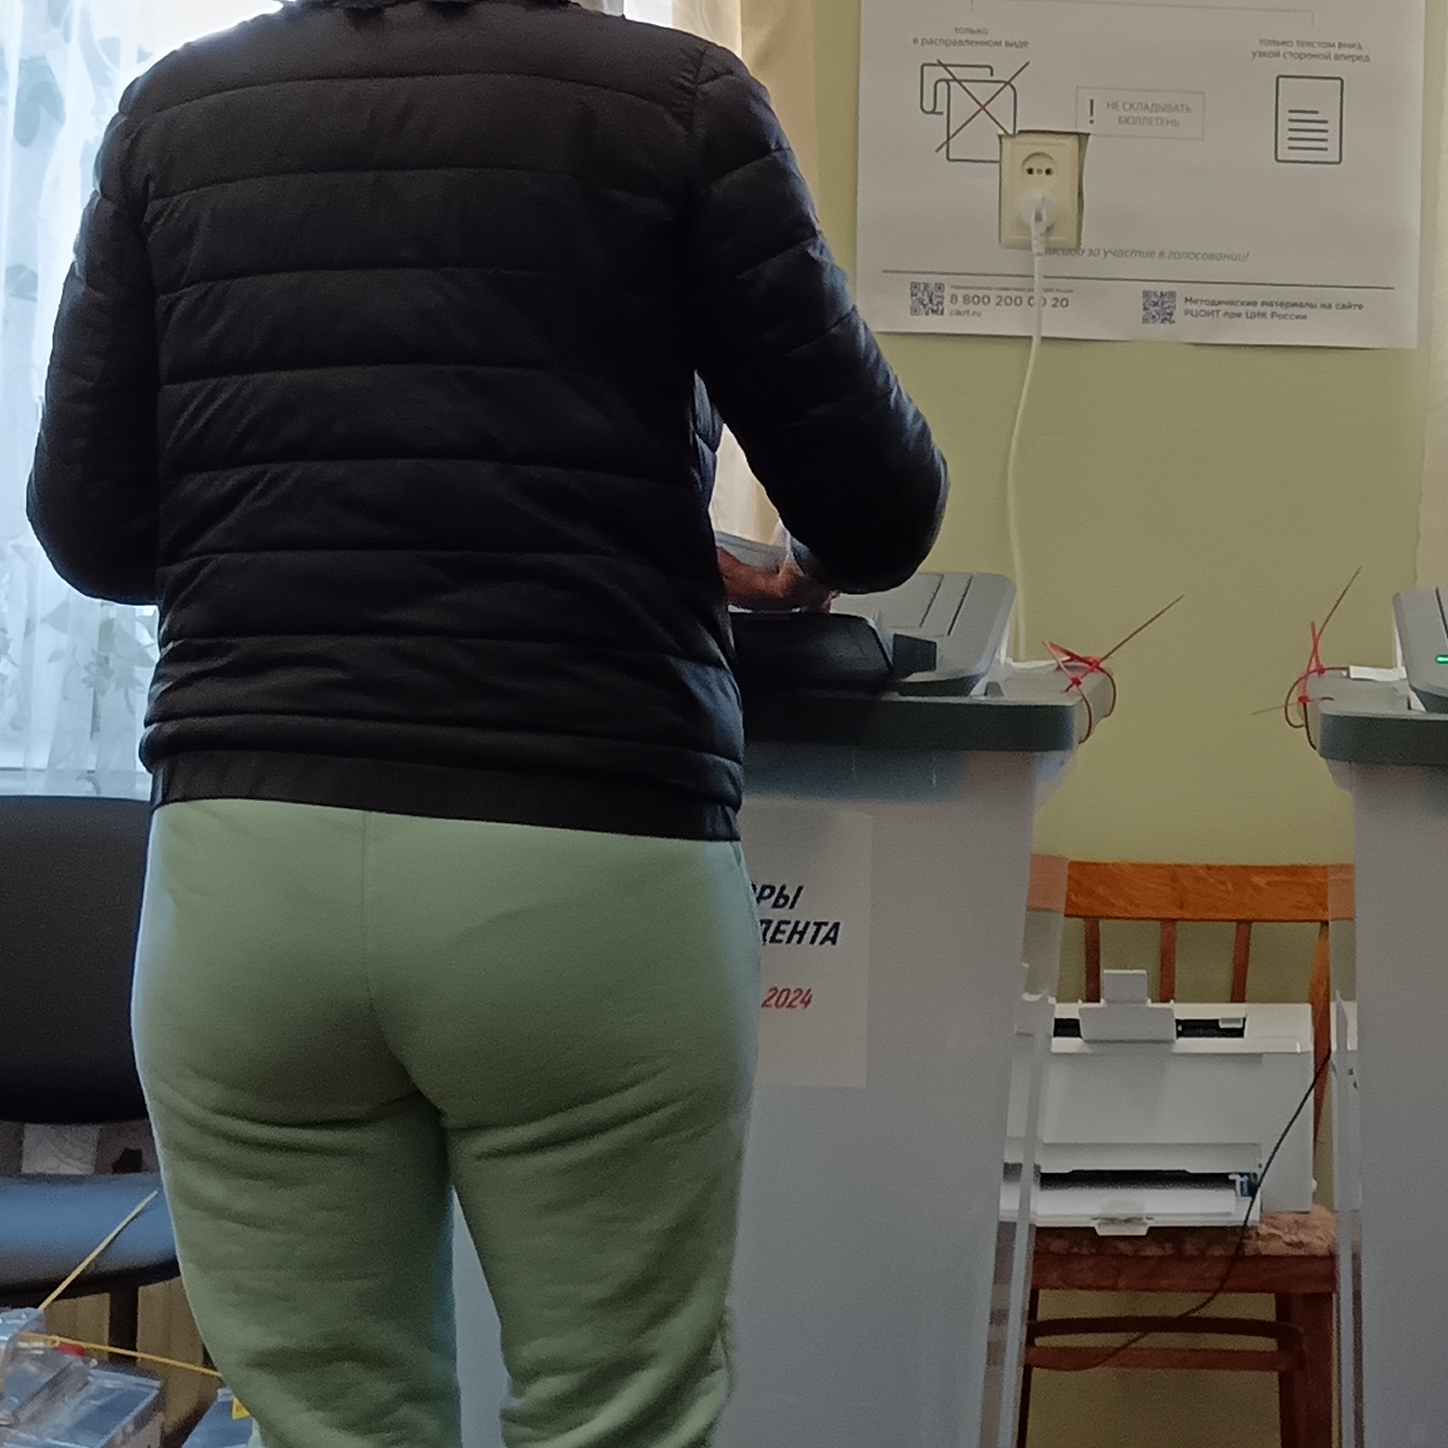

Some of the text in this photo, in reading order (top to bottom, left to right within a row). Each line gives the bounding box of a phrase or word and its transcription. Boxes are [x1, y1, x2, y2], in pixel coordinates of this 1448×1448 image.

[954, 27, 989, 36] только
[921, 37, 1002, 48] расправленном
[1258, 38, 1294, 48] только
[1295, 40, 1336, 49] текстом
[1251, 49, 1371, 64] узкой стороной вперед
[1106, 100, 1192, 114] НЕ СКЛАДЫВАТЬ
[1117, 115, 1181, 128] БЮЛЛЕТЕНЬ
[1101, 249, 1156, 260] участие
[949, 293, 959, 305] 8
[962, 294, 991, 306] 800
[995, 295, 1023, 307] 200
[1051, 297, 1070, 309] 20
[1184, 296, 1258, 307] Методические
[1260, 300, 1318, 310] материалы
[1335, 302, 1364, 310] сайте
[1245, 311, 1268, 320] ЦИК
[1270, 312, 1308, 321] России
[761, 986, 813, 1010] 2024
